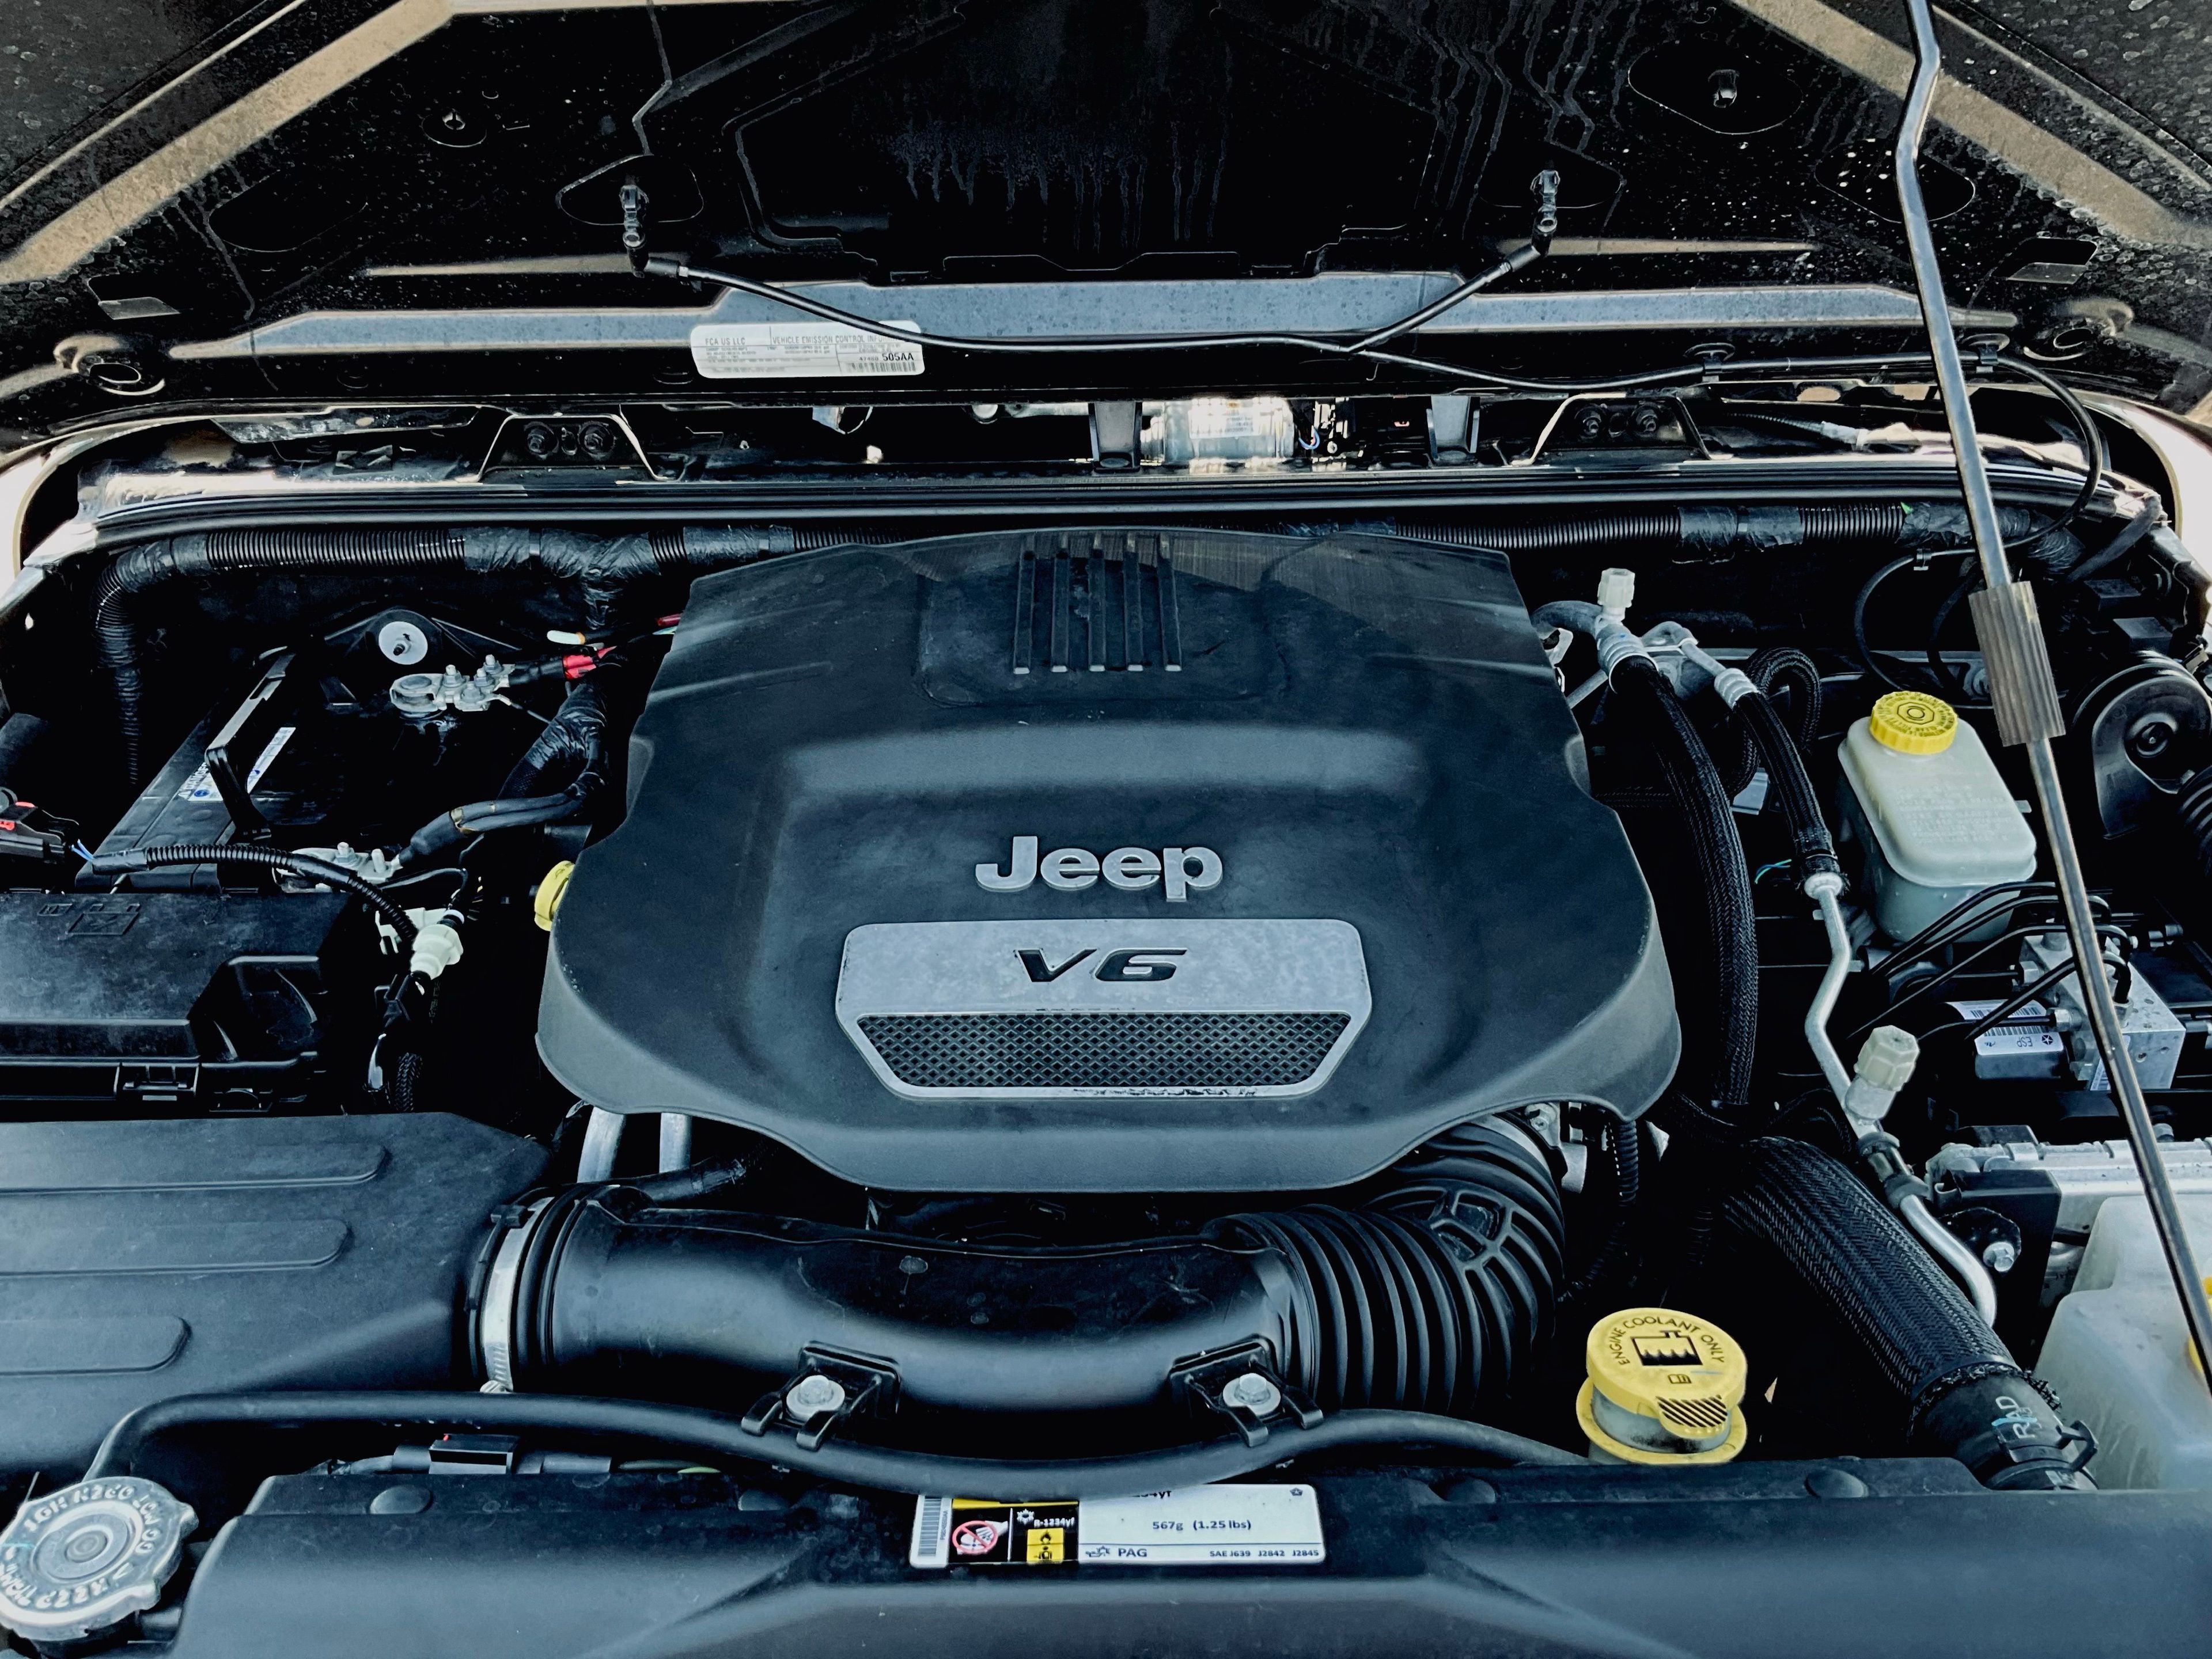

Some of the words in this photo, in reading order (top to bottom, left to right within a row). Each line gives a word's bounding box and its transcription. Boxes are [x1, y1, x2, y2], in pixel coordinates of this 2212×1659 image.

[705, 338, 719, 346] FCA
[772, 336, 800, 344] VEHICLE
[802, 335, 833, 344] EMISSION
[836, 335, 865, 343] CONTROL
[882, 353, 914, 361] 505AA
[975, 835, 1224, 902] Jeep
[1016, 948, 1188, 982] V6
[2017, 1036, 2033, 1047] ESP
[1609, 1327, 1631, 1365] ENGINE
[1623, 1316, 1700, 1333] COOLANT
[1701, 1334, 1725, 1363] ONLY
[1033, 1517, 1075, 1529] R-1234yf
[1153, 1521, 1183, 1531] 567g
[1193, 1520, 1226, 1531] (1.25
[1228, 1520, 1252, 1531] lbs)
[1118, 1548, 1148, 1558] PAG
[1230, 1550, 1251, 1558] J639
[1291, 1549, 1320, 1557] J2845
